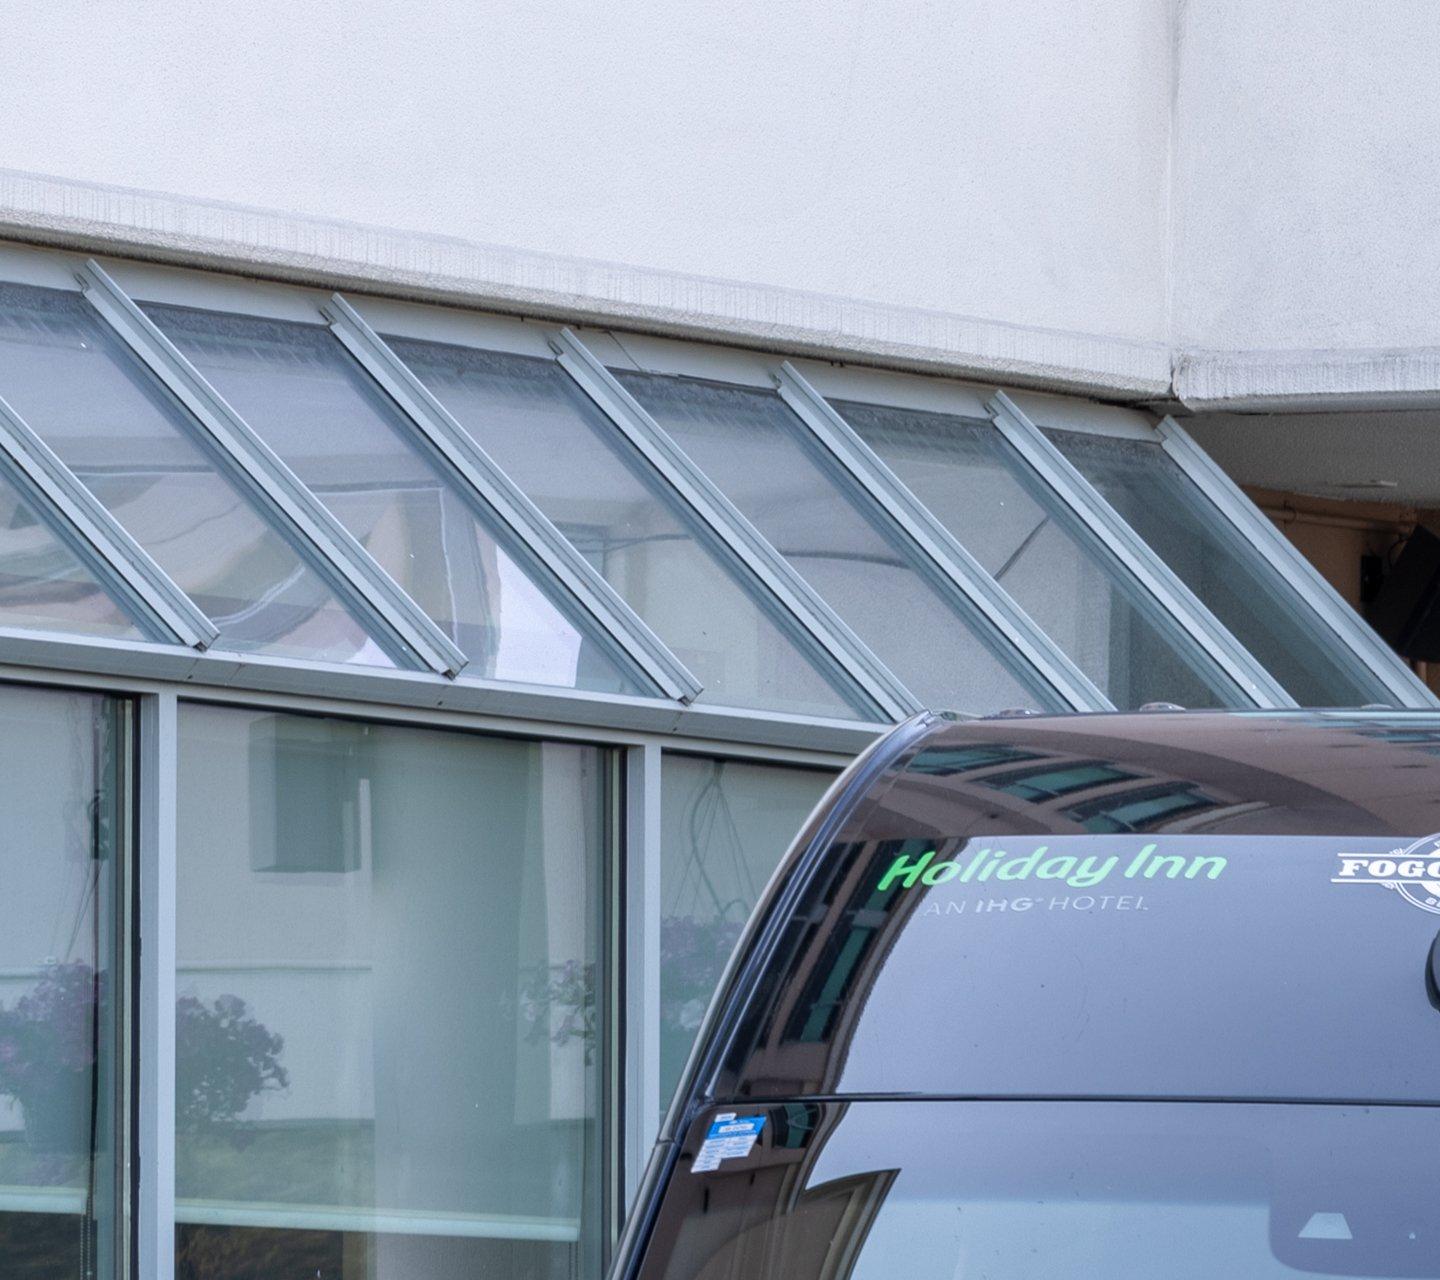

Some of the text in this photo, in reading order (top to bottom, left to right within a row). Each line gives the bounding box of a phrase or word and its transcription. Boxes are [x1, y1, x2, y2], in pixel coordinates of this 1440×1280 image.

[877, 843, 1228, 890] Holiday Inn
[922, 899, 963, 916] AN
[1048, 895, 1143, 911] HOTEL
